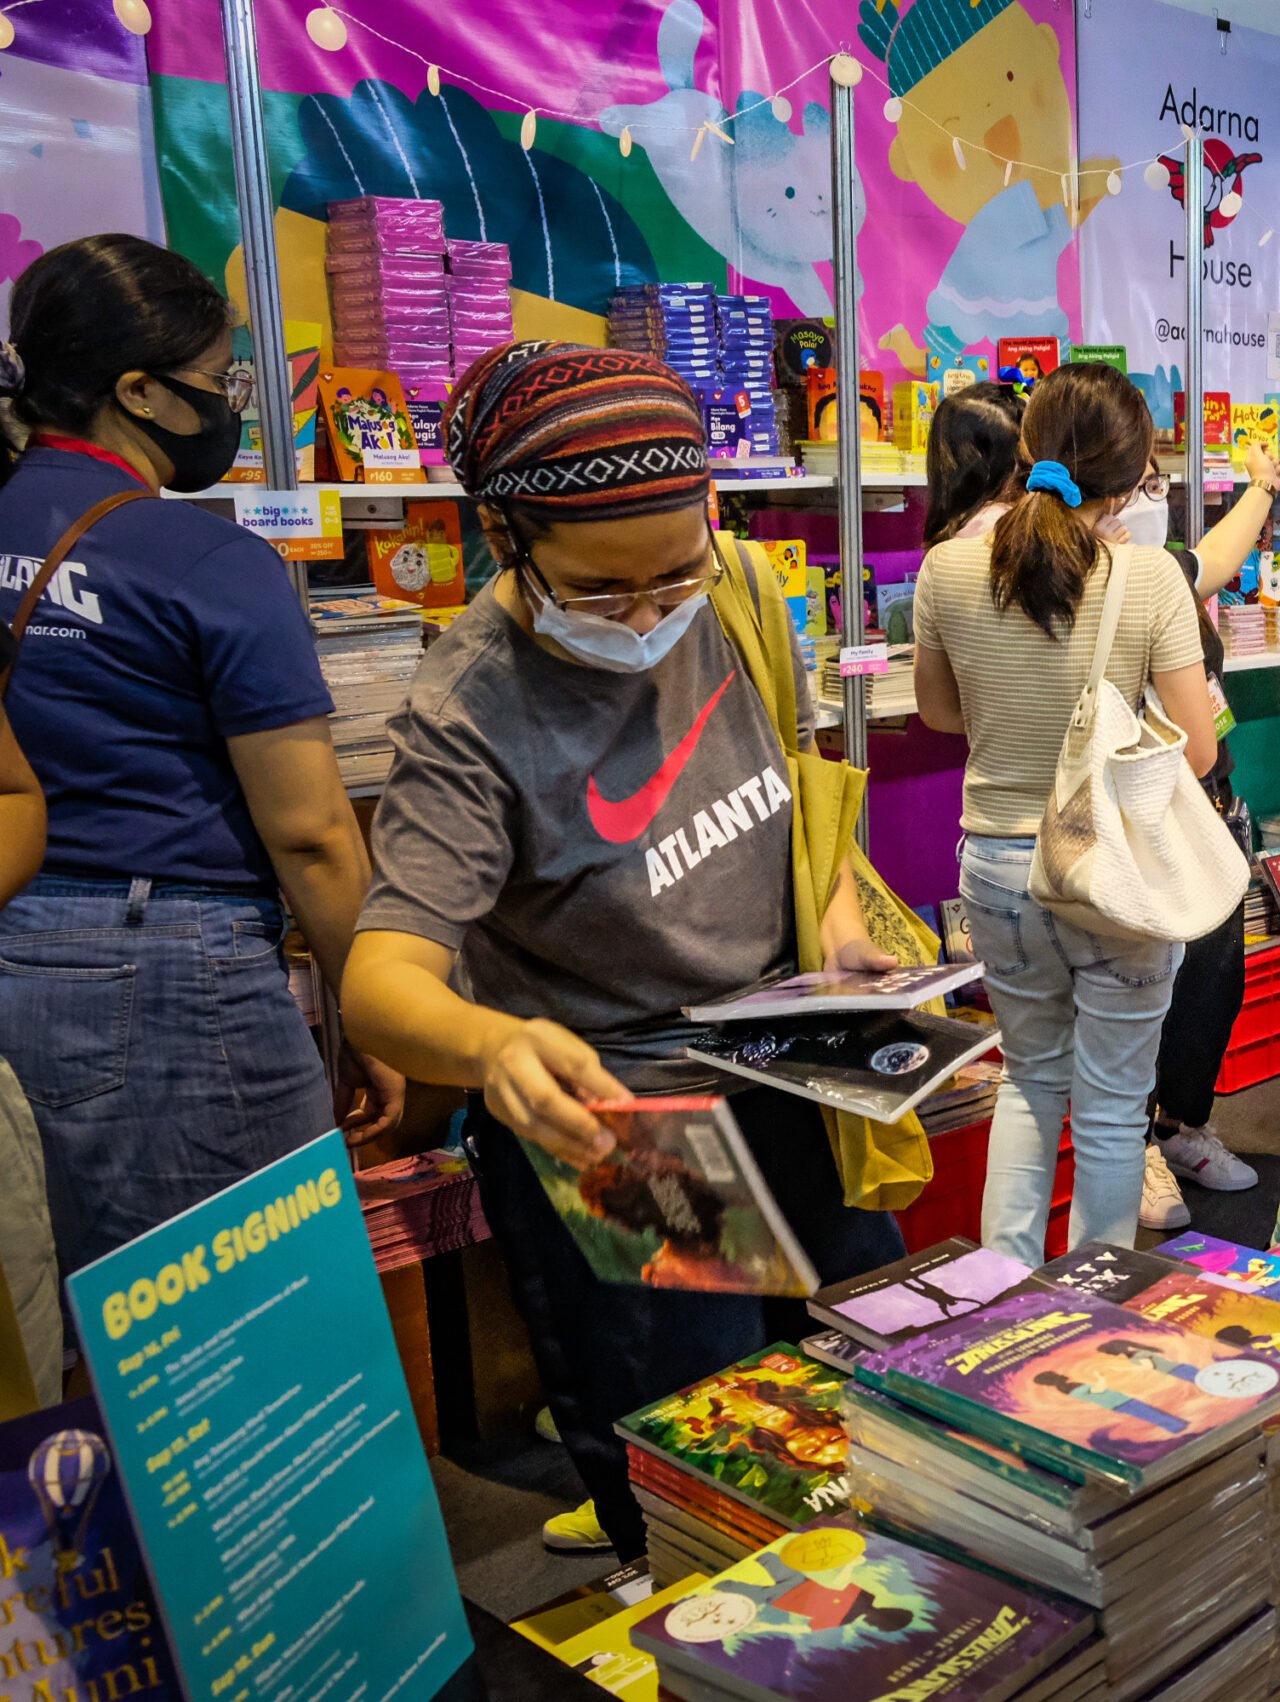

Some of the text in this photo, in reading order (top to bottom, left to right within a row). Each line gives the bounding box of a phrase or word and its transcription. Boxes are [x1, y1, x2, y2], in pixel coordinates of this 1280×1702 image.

[1159, 84, 1259, 142] Adarna
[1170, 240, 1252, 288] Huse
[790, 330, 825, 345] Masaya
[1154, 318, 1266, 348] @anahouse
[348, 415, 396, 433] Malusog
[410, 420, 437, 432] ulay
[710, 422, 736, 433] Bilang
[413, 430, 436, 441] ugis
[373, 454, 397, 462] Malusog
[262, 506, 281, 518] big
[242, 517, 314, 527] board books
[645, 765, 792, 897] ATLANTA
[103, 1167, 342, 1340] BOOK SIGNING
